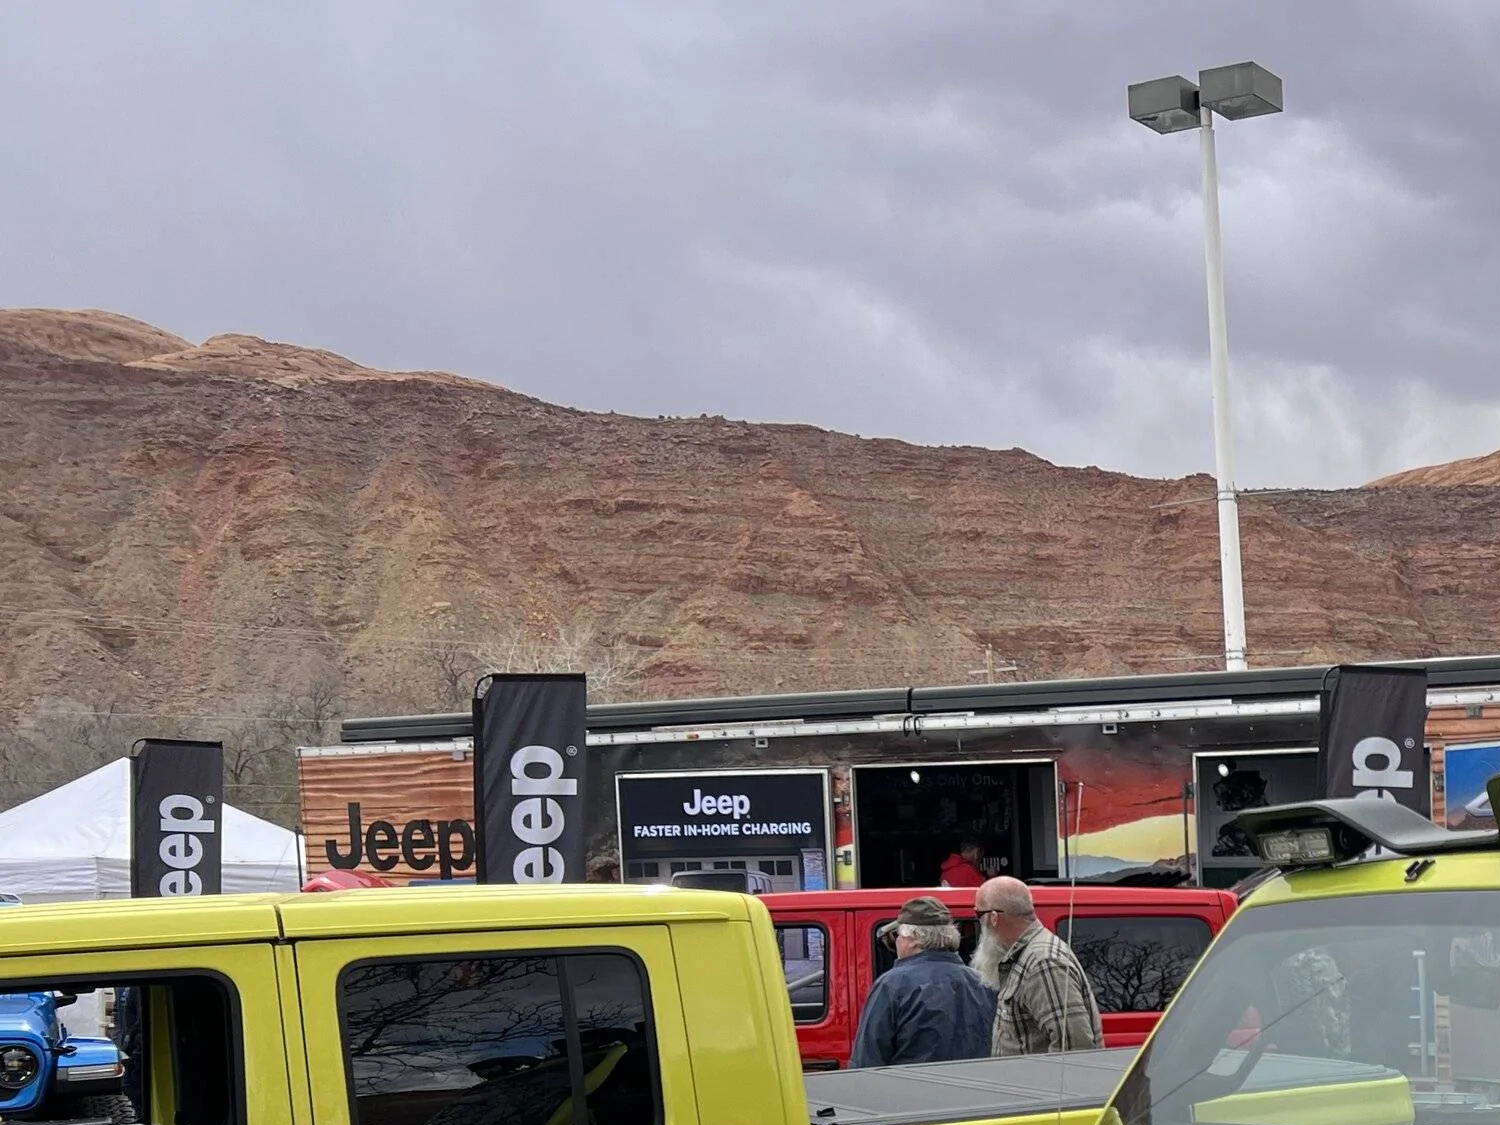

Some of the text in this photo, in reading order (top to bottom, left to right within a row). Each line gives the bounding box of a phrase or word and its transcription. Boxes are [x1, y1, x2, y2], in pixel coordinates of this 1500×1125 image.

[326, 802, 475, 879] Jeep
[510, 745, 577, 884] eep
[634, 822, 812, 838] FASTER IN-HOME CHARGING
[683, 789, 751, 820] Jeep
[159, 794, 215, 896] eep
